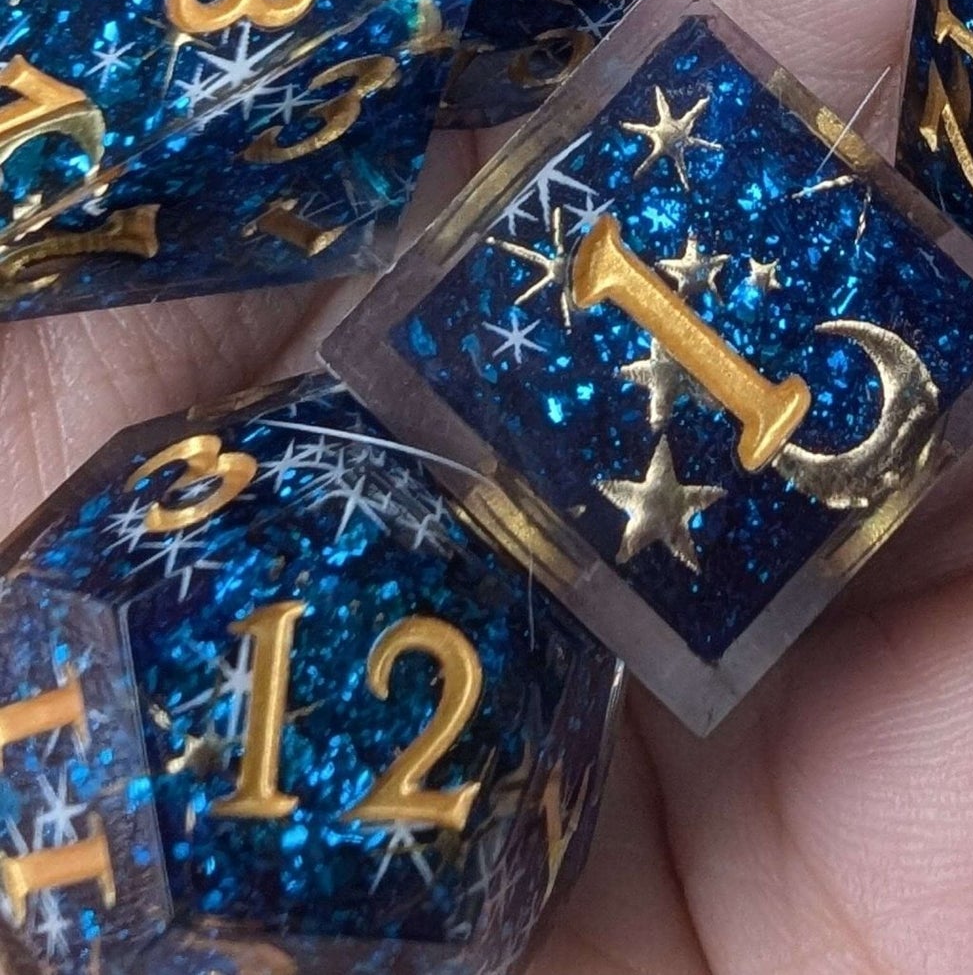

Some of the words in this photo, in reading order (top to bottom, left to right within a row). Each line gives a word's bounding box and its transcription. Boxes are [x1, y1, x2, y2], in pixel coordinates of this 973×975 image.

[573, 213, 812, 472] 1
[124, 434, 259, 533] 3
[207, 599, 482, 830] 12
